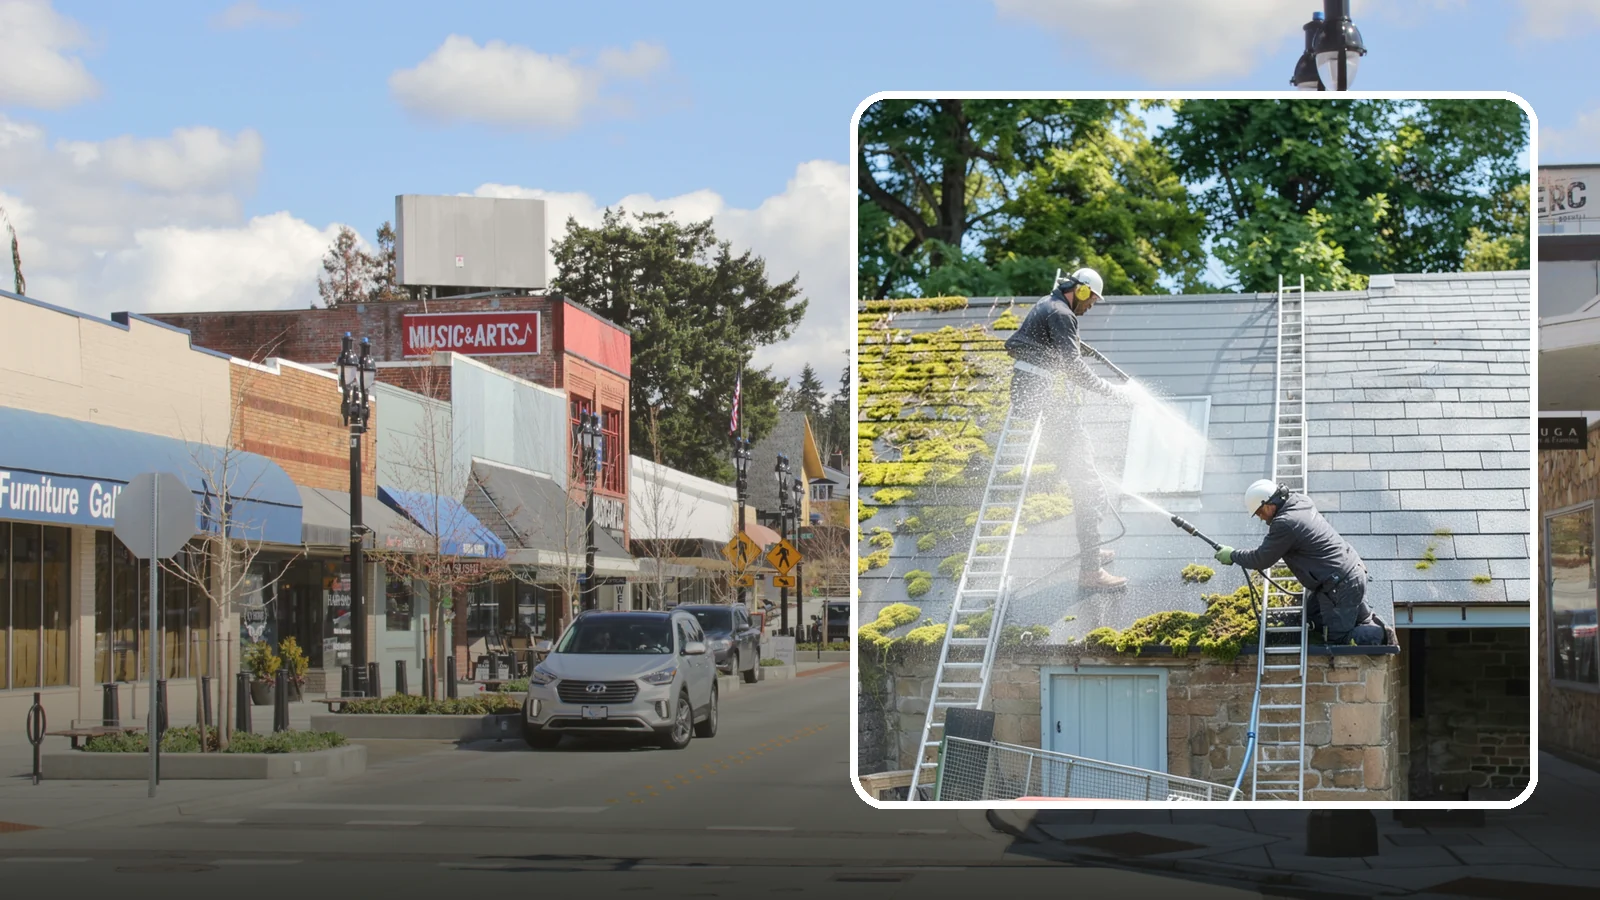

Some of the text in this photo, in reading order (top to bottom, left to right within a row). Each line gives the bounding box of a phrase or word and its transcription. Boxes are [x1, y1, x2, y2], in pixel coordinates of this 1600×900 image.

[408, 322, 520, 349] MUSIC&ARTS
[1540, 428, 1577, 436] UGA
[0, 471, 122, 519] Furniture Gal
[453, 561, 480, 575] SUSHI
